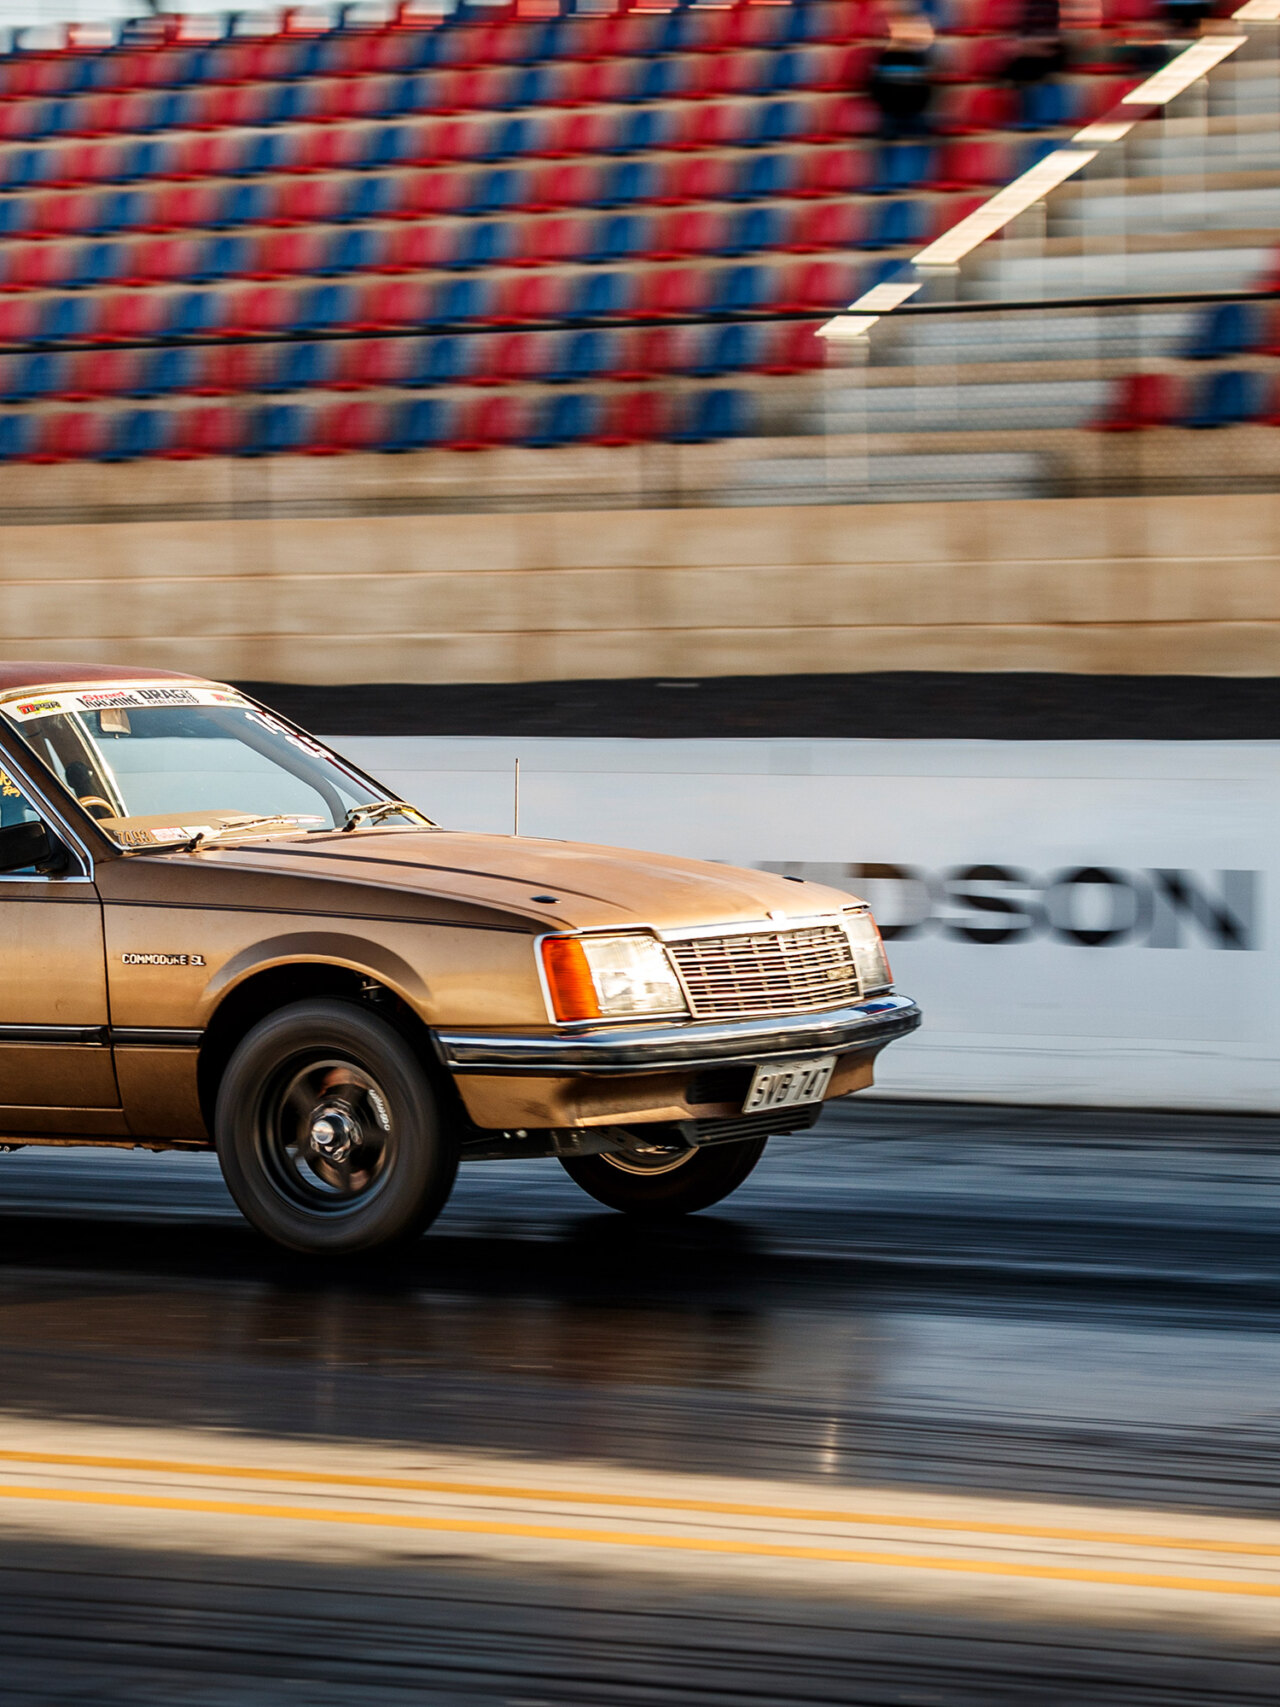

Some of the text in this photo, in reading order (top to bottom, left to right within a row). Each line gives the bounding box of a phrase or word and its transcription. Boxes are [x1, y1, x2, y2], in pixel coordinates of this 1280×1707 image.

[135, 689, 187, 699] DRAG
[114, 829, 152, 845] 7493
[756, 862, 1267, 951] DSON
[121, 953, 188, 966] COMMODORE
[751, 1067, 831, 1107] SVB-747
